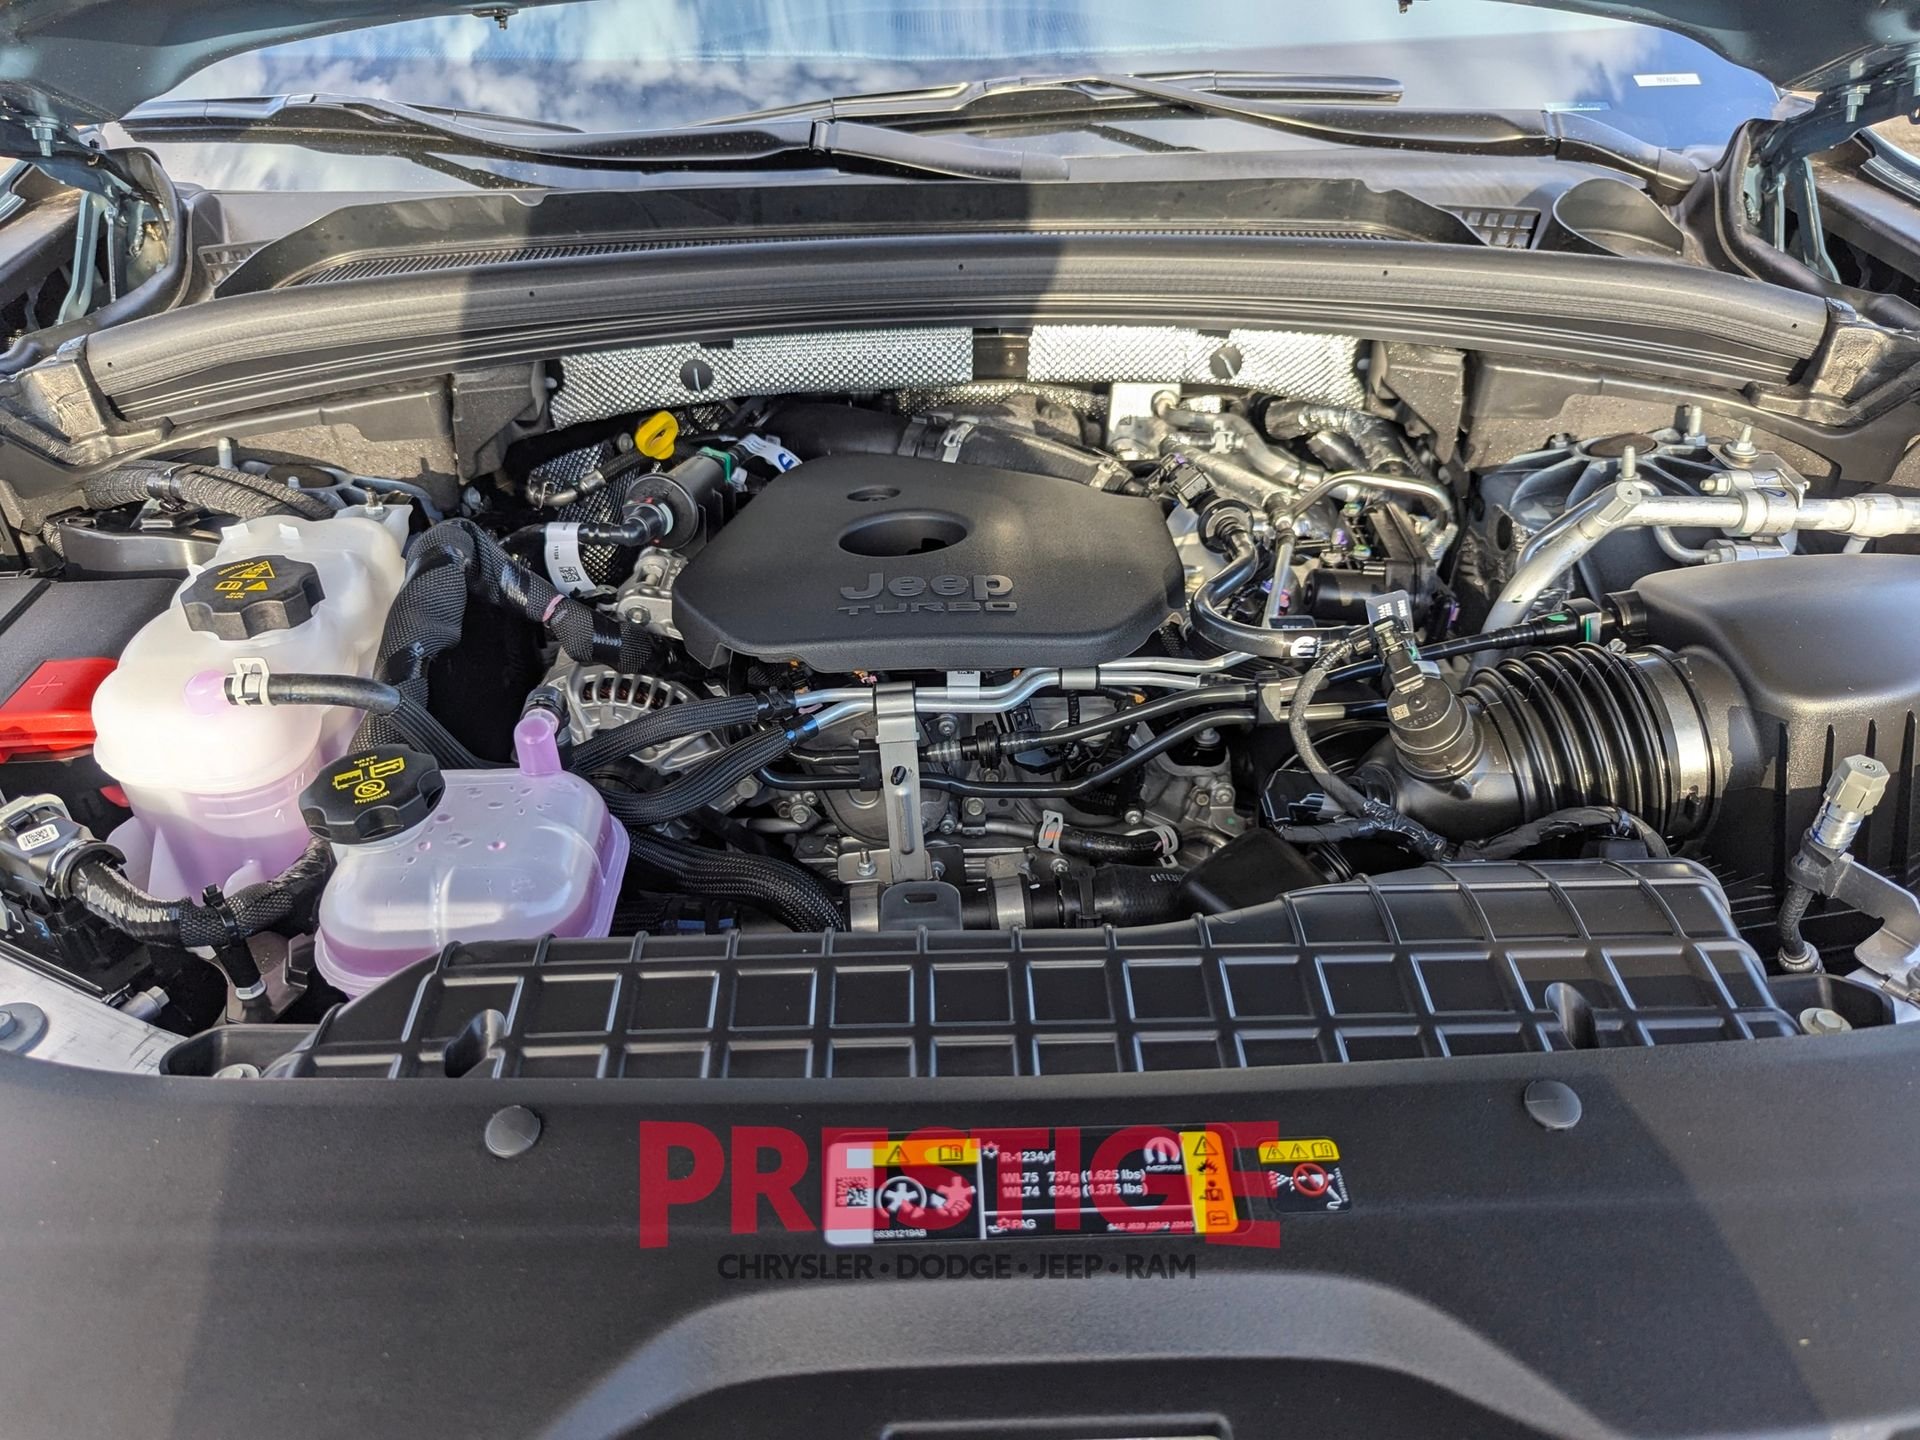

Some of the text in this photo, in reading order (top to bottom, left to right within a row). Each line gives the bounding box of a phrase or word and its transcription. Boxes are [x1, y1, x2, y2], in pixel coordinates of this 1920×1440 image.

[839, 572, 1014, 601] Jeep
[836, 600, 1018, 616] TURBO
[1000, 1150, 1056, 1163] R-1234yf
[1001, 1168, 1146, 1184] WL75 737g (1.625 lbs)
[1002, 1182, 1149, 1198] WL74 624g (1.375 lbs)
[1012, 1217, 1037, 1230] PAG
